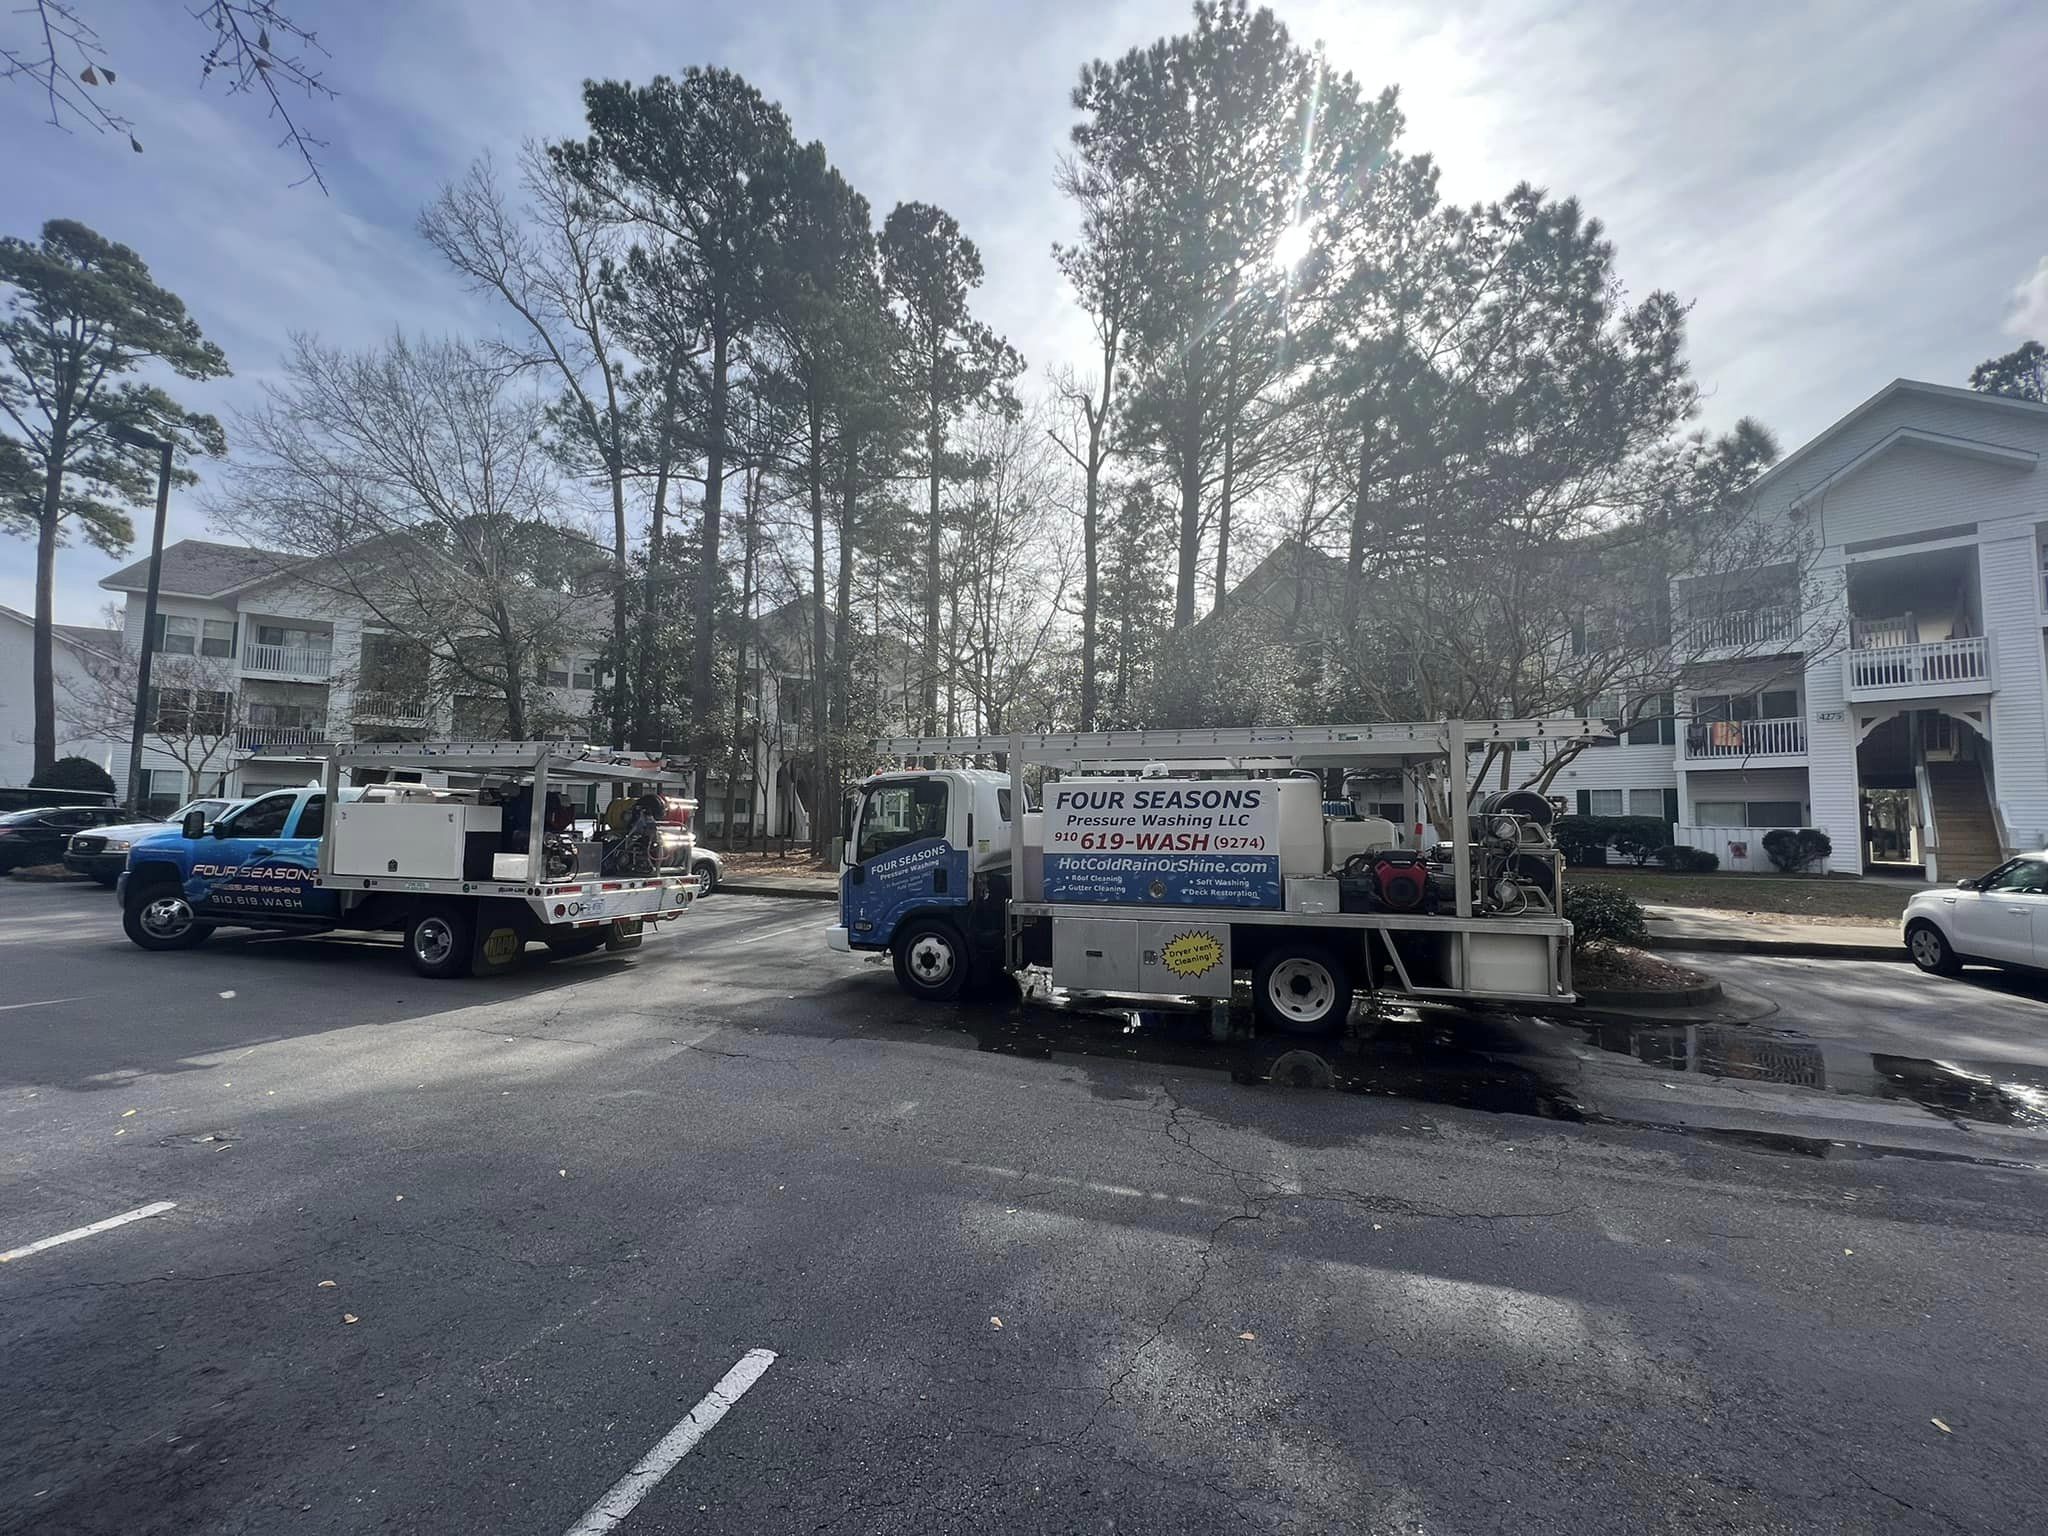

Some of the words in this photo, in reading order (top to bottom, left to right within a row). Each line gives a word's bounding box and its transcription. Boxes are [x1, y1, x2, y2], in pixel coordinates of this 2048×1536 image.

[1056, 791, 1125, 810] FOUR
[1133, 790, 1261, 809] SEASONS
[1066, 815, 1136, 826] Pressure
[1142, 814, 1212, 829] Washing
[1218, 814, 1250, 826] LLC
[1054, 832, 1078, 842] 910
[1080, 832, 1209, 851] 619-WASH
[1213, 836, 1265, 851] (9274)
[871, 860, 898, 875] FOUR
[899, 844, 946, 867] SEASONS
[1058, 857, 1268, 873] HotColdRainOrShine.com
[192, 864, 238, 877] FOUR
[239, 867, 319, 880] SEASONS
[879, 867, 909, 881] Pressure
[910, 860, 940, 872] Washing
[1090, 875, 1123, 884] Cleaning
[1214, 879, 1250, 888] Washing
[260, 885, 302, 894] WASHING
[1093, 885, 1126, 894] Cleaning
[1188, 888, 1209, 896] Deck
[1210, 889, 1258, 897] Restoration
[1169, 947, 1191, 958] Dryer
[1193, 943, 1213, 952] Vent
[1174, 952, 1212, 966] Cleaning!
